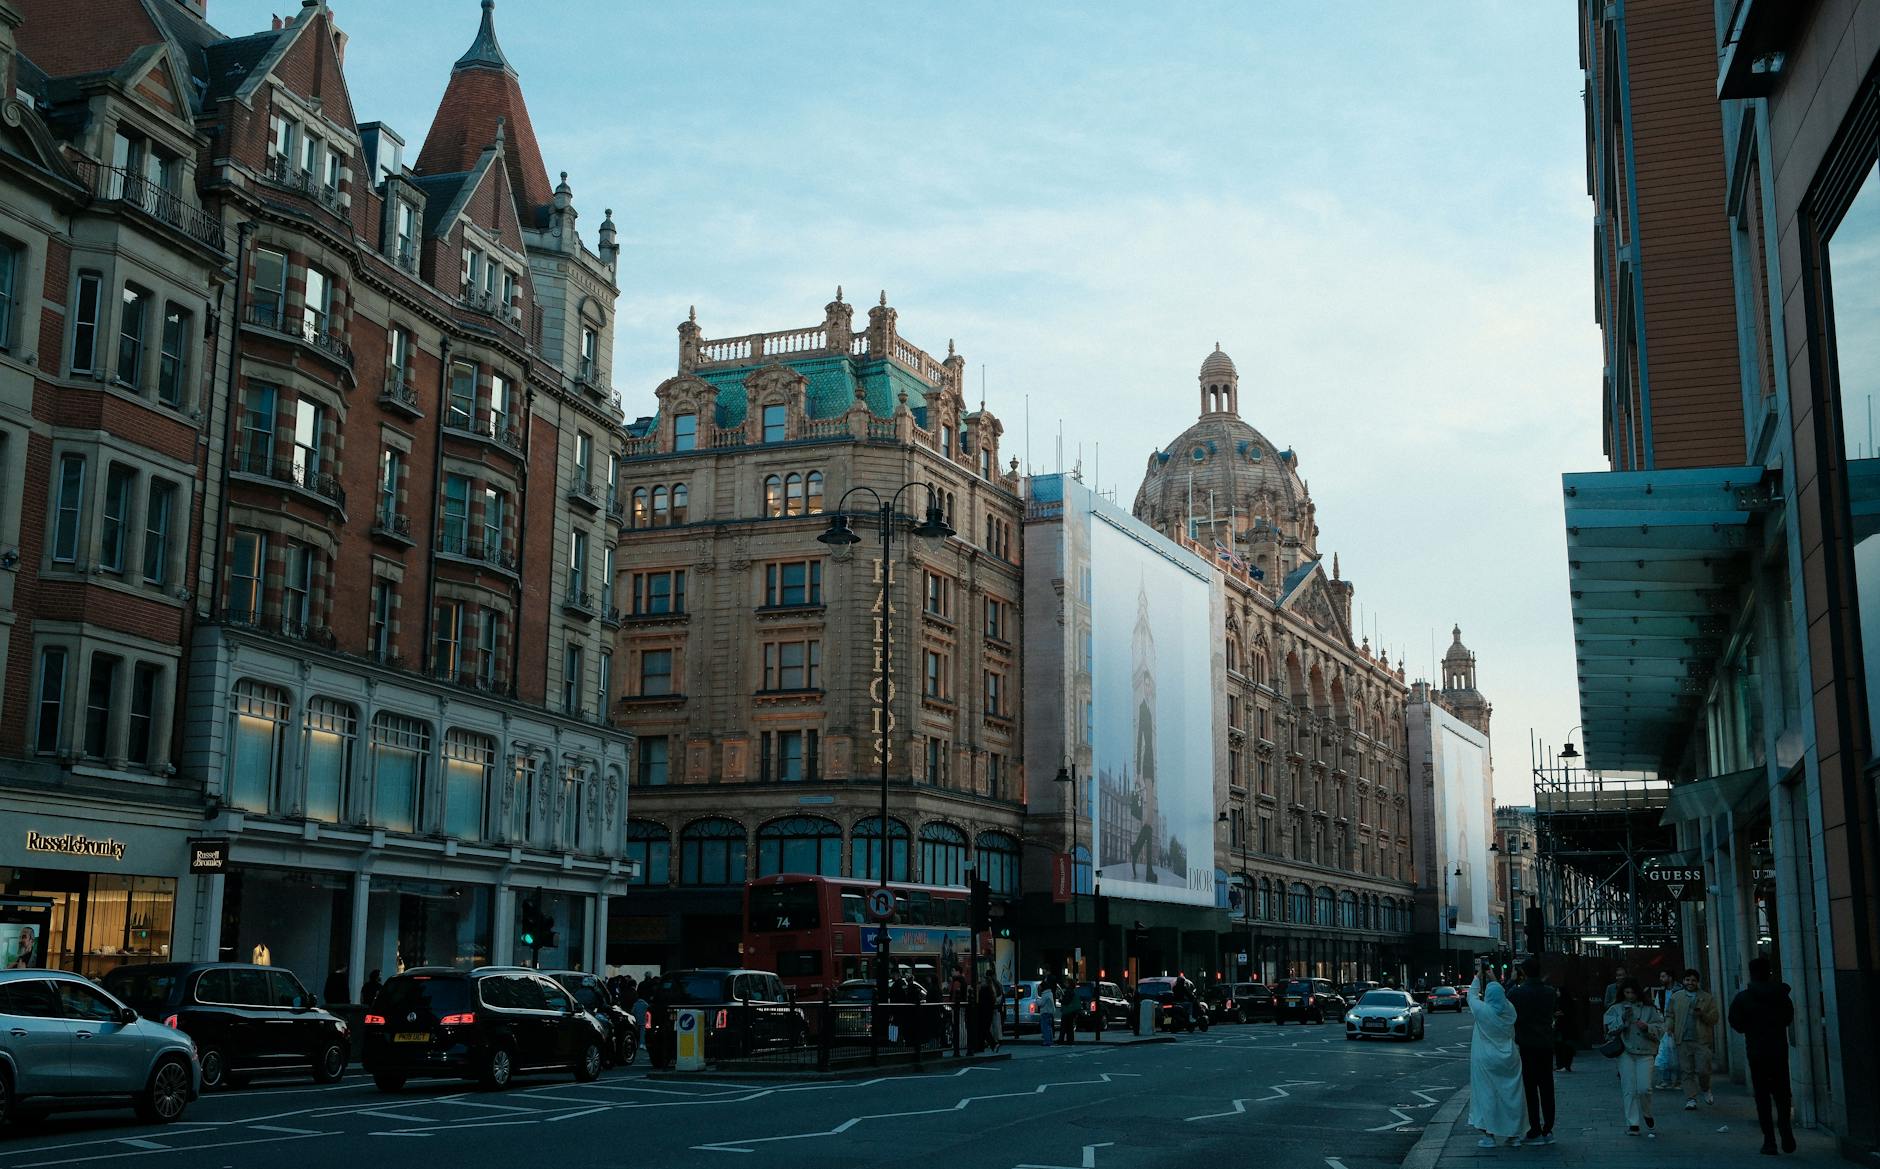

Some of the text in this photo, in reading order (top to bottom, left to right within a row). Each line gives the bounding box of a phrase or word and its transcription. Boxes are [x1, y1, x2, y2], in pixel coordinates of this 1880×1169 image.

[196, 850, 220, 860] Russell
[1189, 867, 1213, 893] DIOR
[1649, 870, 1701, 881] GUESS
[776, 916, 791, 929] 74
